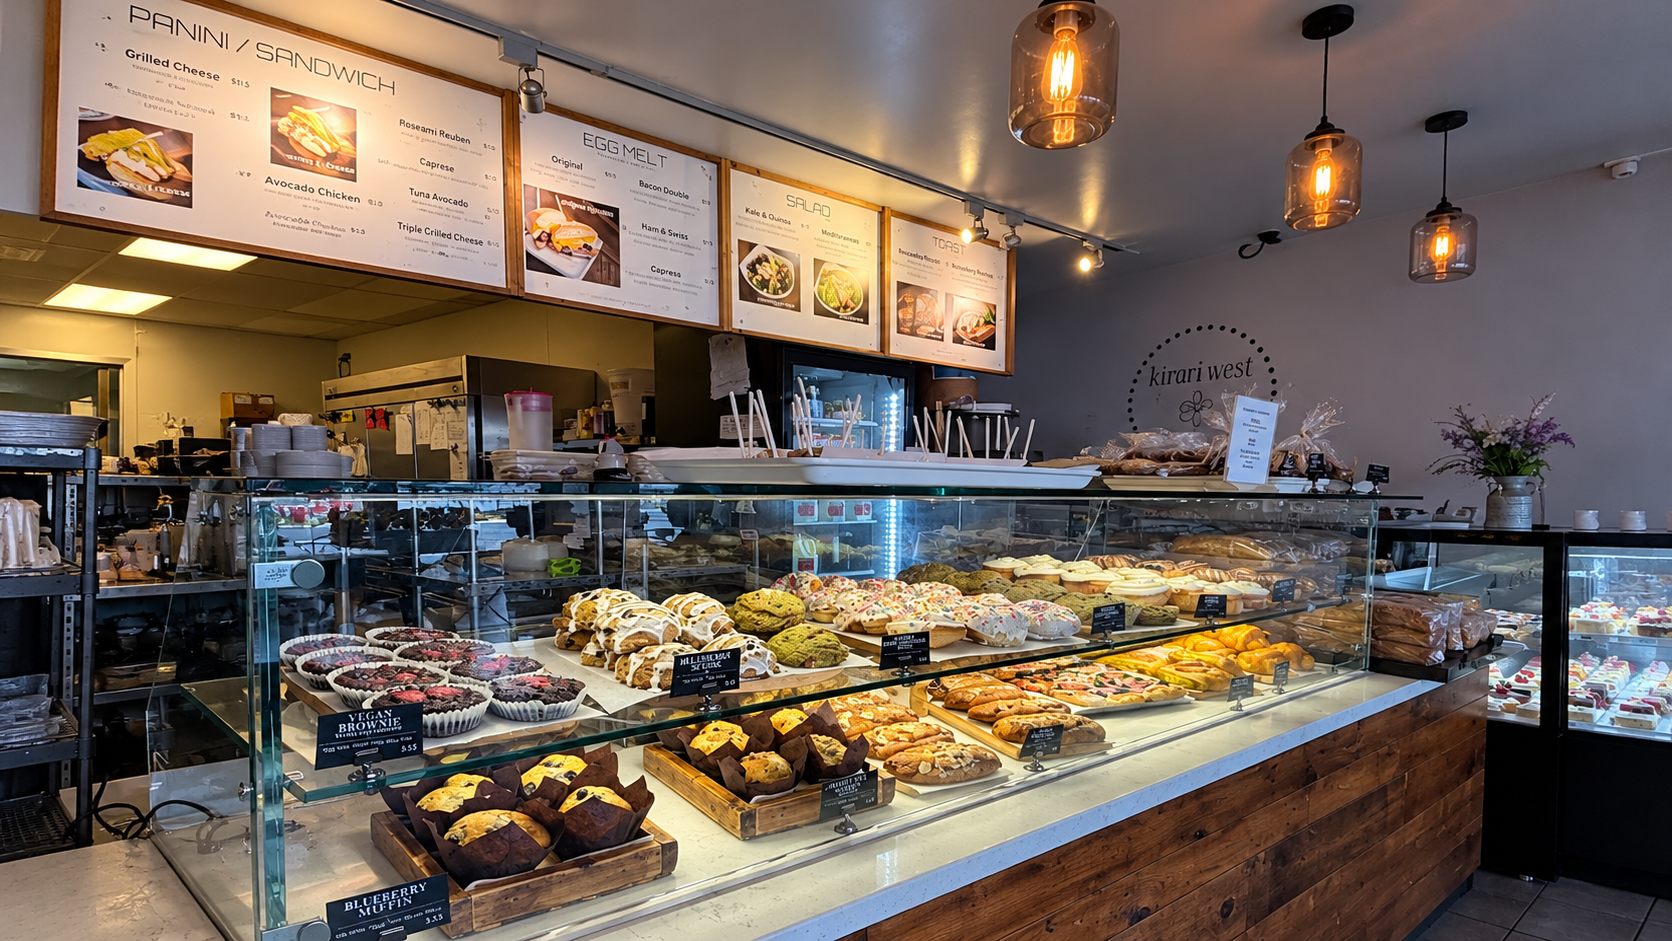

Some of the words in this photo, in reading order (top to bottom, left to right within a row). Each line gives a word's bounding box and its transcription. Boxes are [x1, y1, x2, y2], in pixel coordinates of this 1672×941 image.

[130, 5, 228, 50] PANINI
[236, 39, 250, 52] /
[256, 42, 395, 96] SANDWICH
[125, 49, 170, 68] Grilled
[173, 62, 221, 82] Cheese
[439, 130, 471, 146] Reuben
[583, 132, 619, 155] EGG
[622, 144, 668, 168] MELT
[419, 157, 455, 174] Caprese
[551, 155, 583, 171] Original
[264, 176, 315, 194] Avocado
[317, 187, 362, 205] Chicken
[408, 187, 430, 199] Tuna
[432, 193, 469, 209] Avocado
[639, 179, 662, 194] Bacon
[663, 186, 690, 200] Double
[786, 194, 831, 218] SALAD
[397, 221, 423, 236] Triple
[454, 233, 484, 247] Cheese
[641, 222, 660, 235] Ham
[660, 227, 667, 236] &
[667, 228, 689, 241] Swiss
[1149, 361, 1203, 387] kirari
[1207, 356, 1254, 381] west
[338, 717, 402, 733] BROWNIE
[348, 709, 393, 722] VEGAN
[344, 882, 428, 912] BLUEBERRY
[358, 896, 413, 918] MUFFIN
